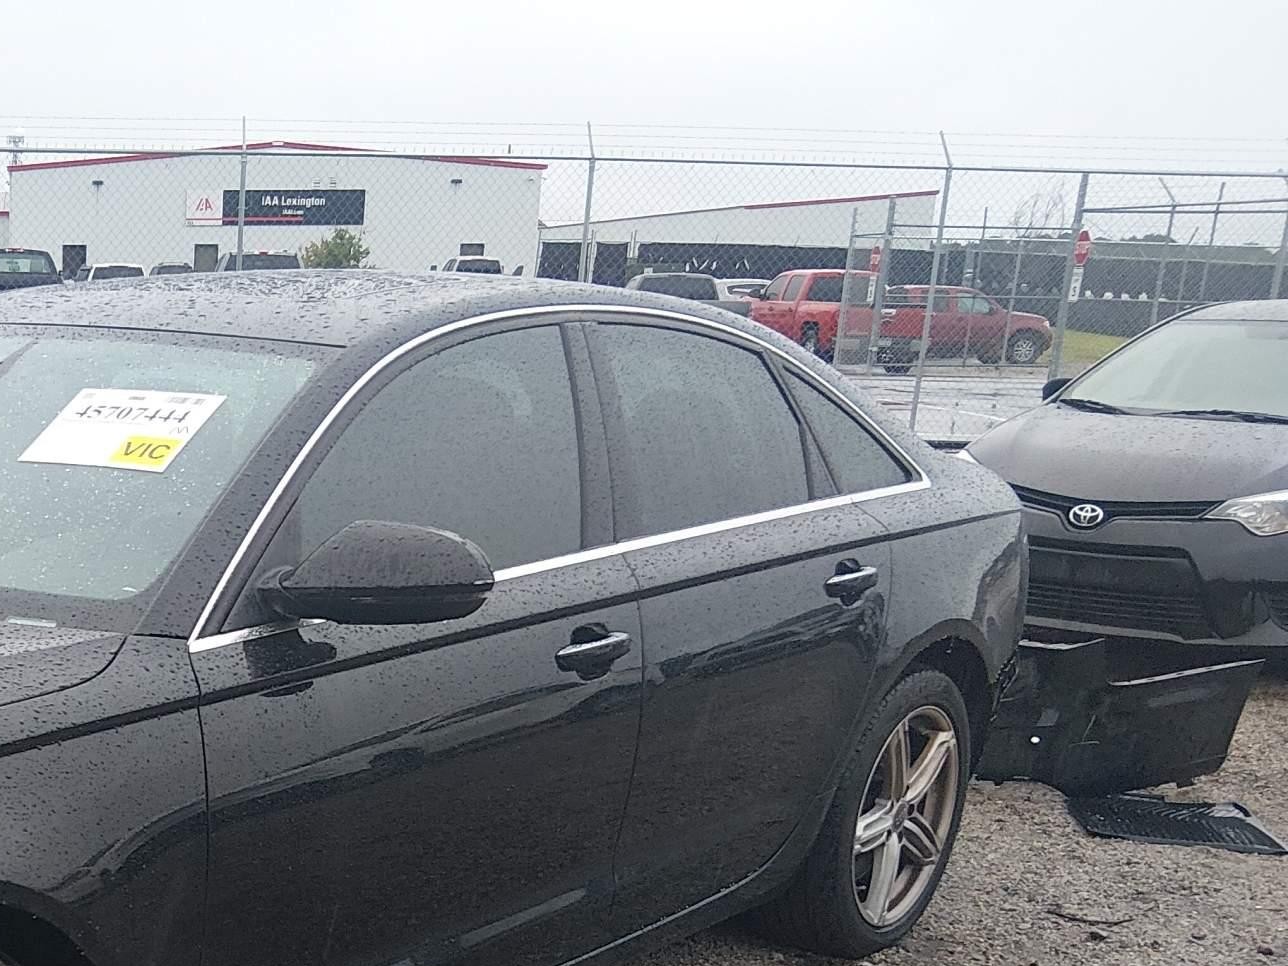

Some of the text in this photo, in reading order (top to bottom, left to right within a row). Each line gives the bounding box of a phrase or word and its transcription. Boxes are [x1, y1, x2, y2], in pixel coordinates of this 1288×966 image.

[261, 195, 326, 208] IAA Lexington
[75, 404, 192, 424] 45707444
[123, 440, 171, 460] VIC
